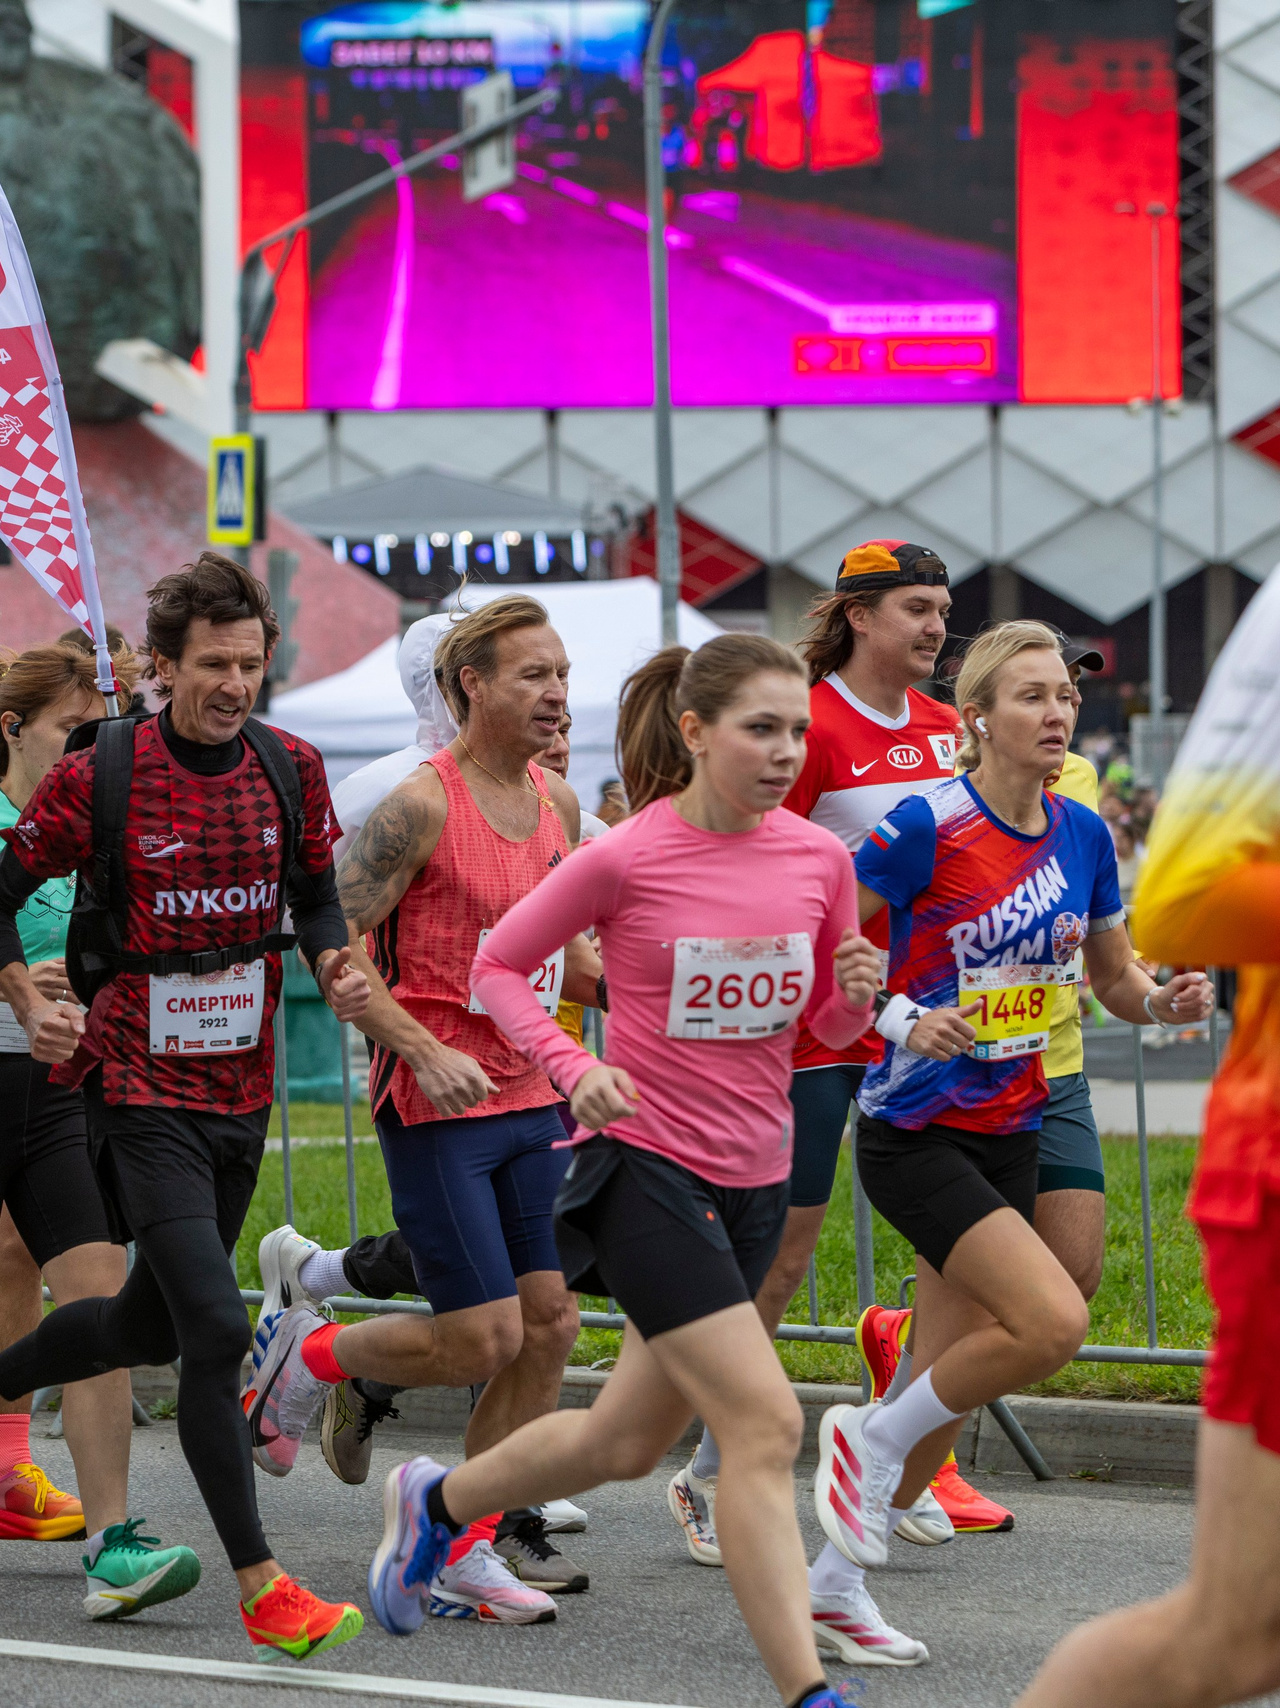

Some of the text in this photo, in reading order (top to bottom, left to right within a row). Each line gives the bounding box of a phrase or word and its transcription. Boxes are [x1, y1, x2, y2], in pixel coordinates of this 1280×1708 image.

[892, 750, 919, 763] KIA
[153, 879, 278, 915] ЛУКОЙЛ
[945, 855, 1068, 969] RUSSIAN
[533, 962, 556, 992] 21
[685, 970, 803, 1009] 2605
[166, 993, 254, 1013] СМЕРТИН
[977, 987, 1046, 1026] 1448
[199, 1017, 228, 1028] 2922
